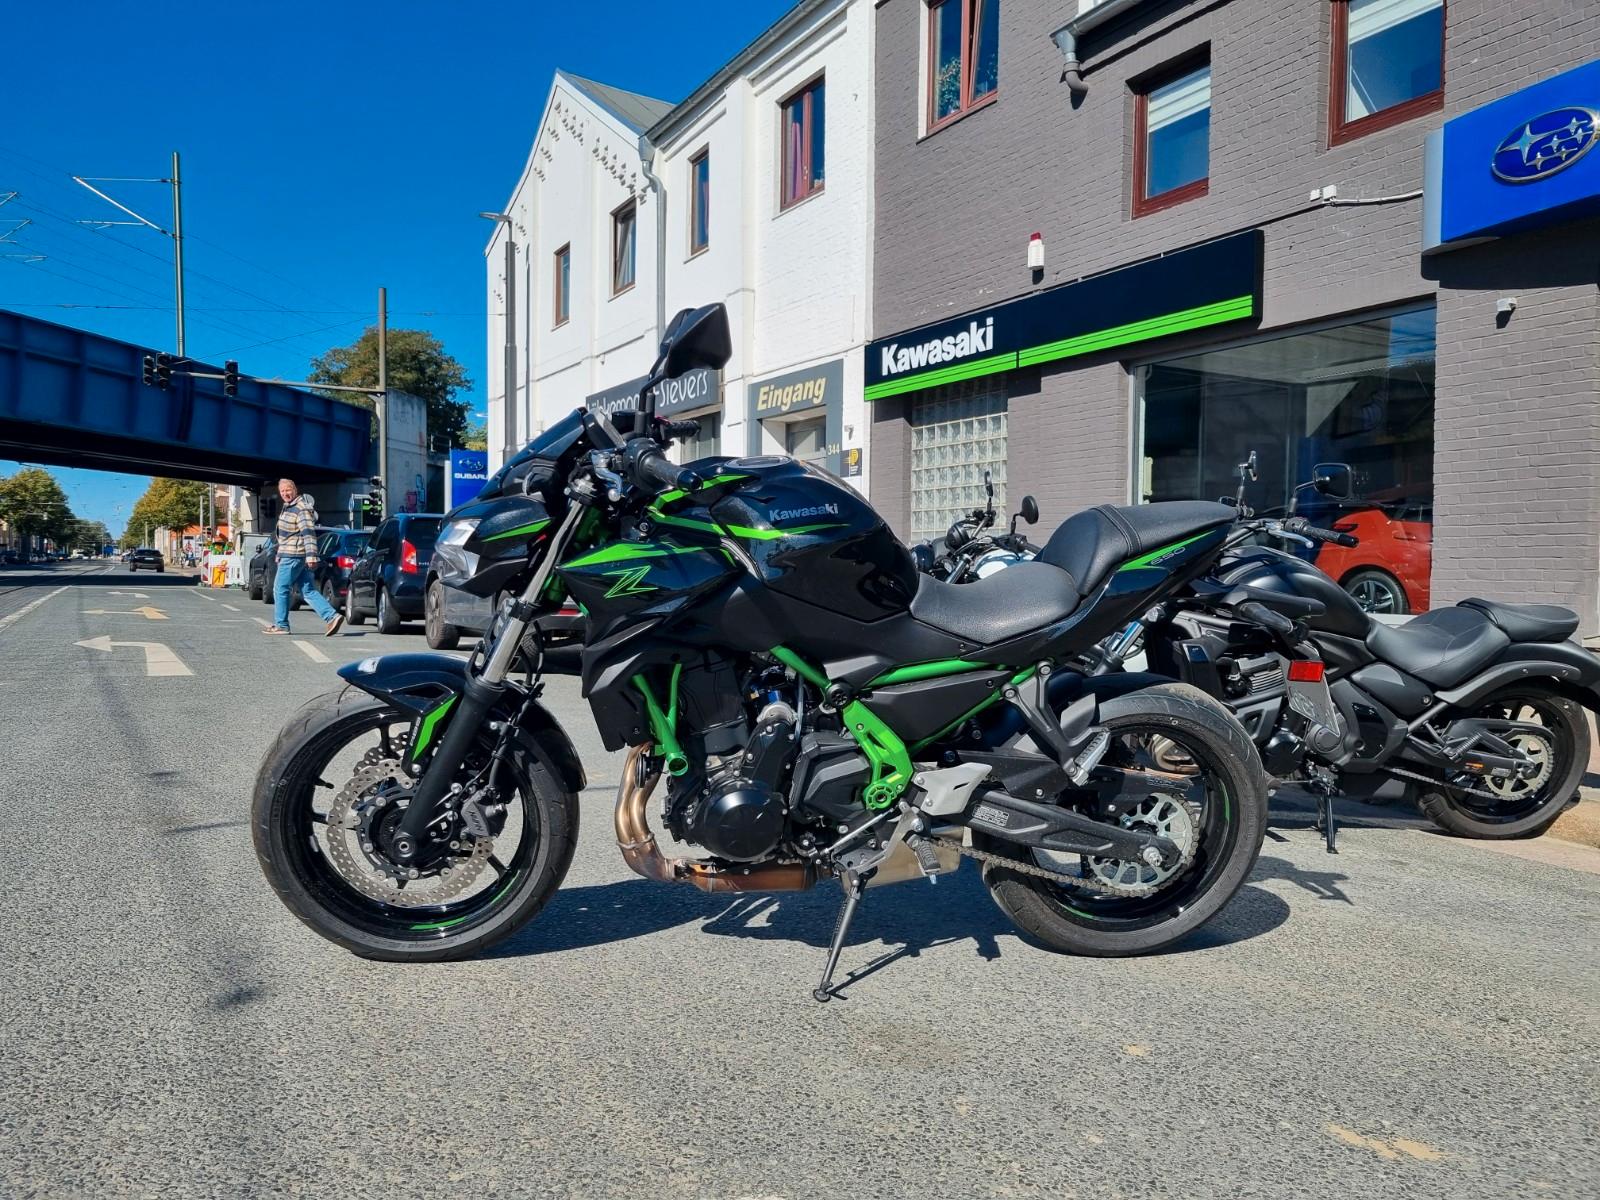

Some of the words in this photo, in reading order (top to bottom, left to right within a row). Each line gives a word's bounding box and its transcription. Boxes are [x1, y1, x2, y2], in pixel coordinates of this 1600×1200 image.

[882, 317, 994, 376] Kawasaki
[660, 371, 708, 407] Sievers
[757, 377, 826, 412] Eingang
[827, 442, 840, 456] 344
[769, 503, 839, 521] Kawasaki
[602, 565, 659, 599] Z
